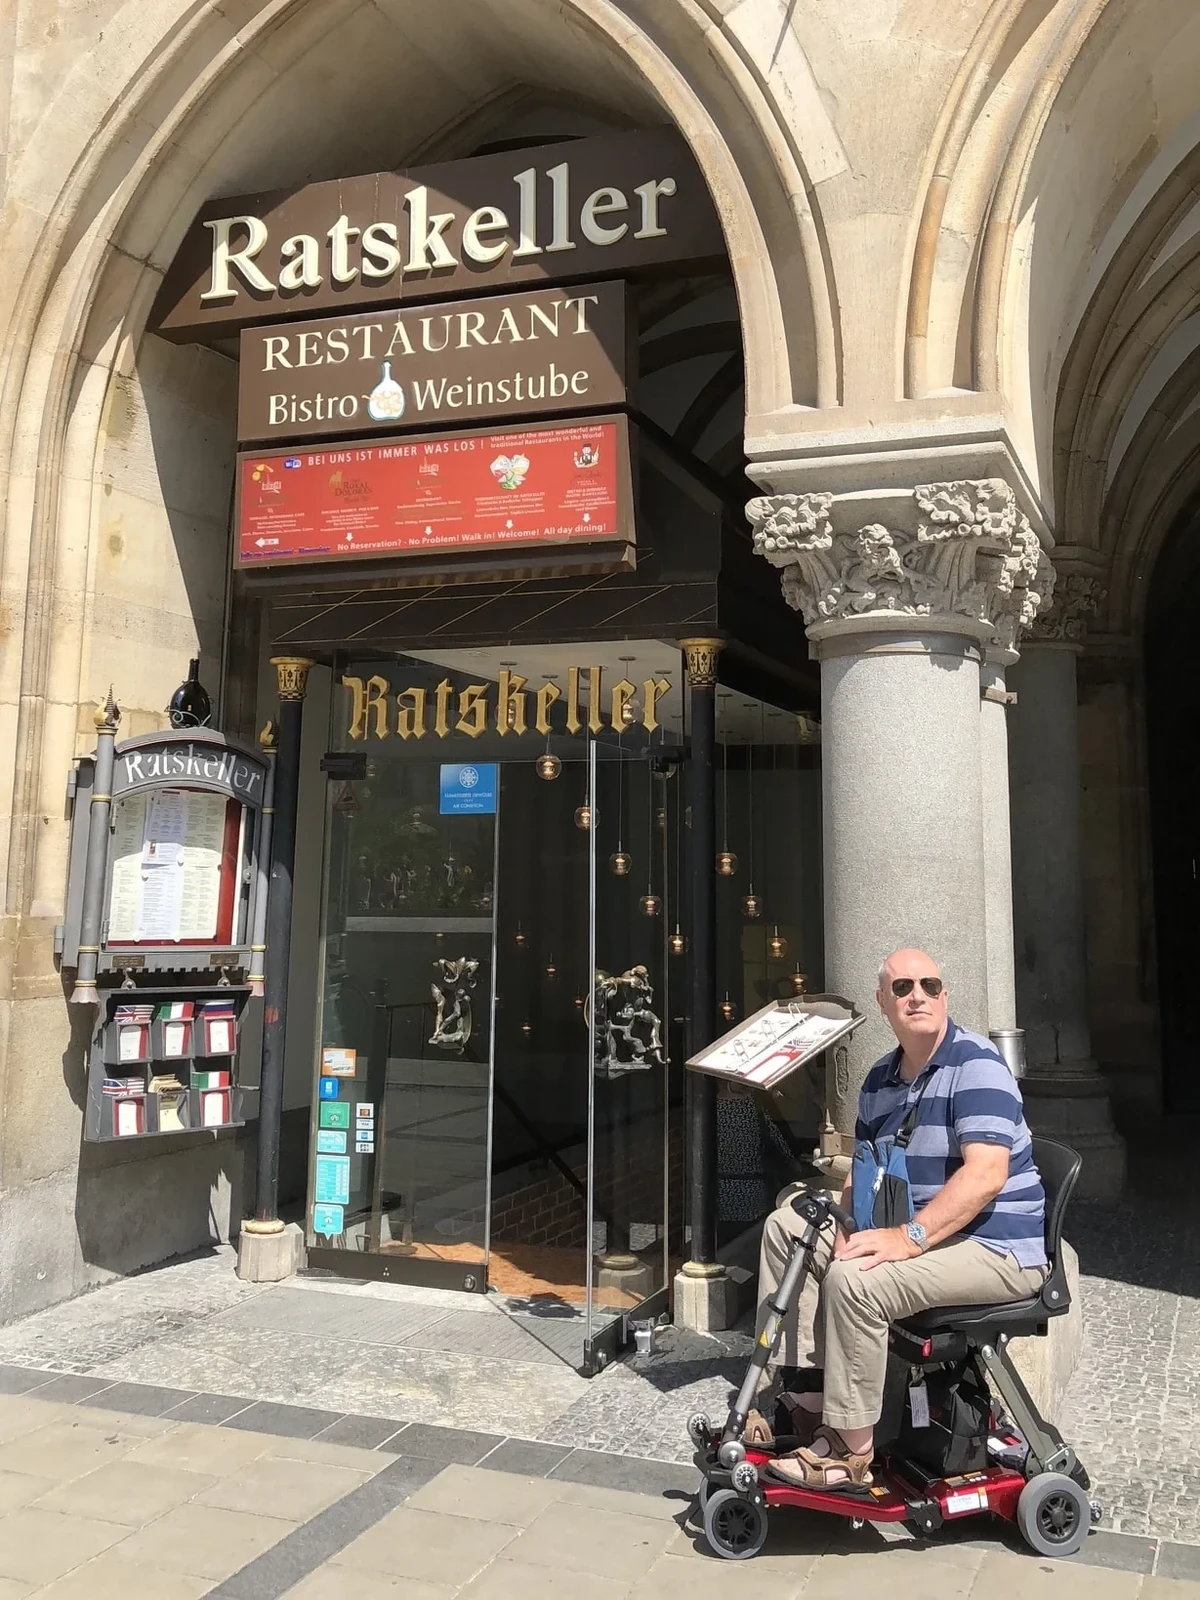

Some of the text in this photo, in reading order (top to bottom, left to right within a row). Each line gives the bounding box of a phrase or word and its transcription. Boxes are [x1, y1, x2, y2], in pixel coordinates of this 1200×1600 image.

[201, 162, 677, 300] Ratskeller
[261, 295, 599, 372] RESTAURANT
[269, 364, 589, 425] Bistro Weinstube
[308, 456, 325, 466] BEI
[329, 453, 352, 464] UNS
[356, 450, 373, 461] IST
[378, 446, 417, 460] IMMER
[424, 443, 449, 455] WAS
[453, 440, 475, 452] LOS
[490, 435, 504, 443] Visit
[553, 427, 588, 436] wonderful
[490, 431, 604, 448] traditional Restaurants in the World!
[337, 542, 349, 551] No
[350, 538, 402, 550] Reservation?
[408, 536, 421, 546] No
[421, 532, 460, 545] Problem!
[461, 532, 482, 542] Walk
[484, 531, 495, 540] in!
[497, 528, 540, 539] Welcome!
[543, 526, 556, 535] All
[557, 525, 573, 536] day
[574, 522, 607, 533] dining!
[342, 666, 672, 741] Ratskeller
[125, 743, 261, 793] Ratskeller
